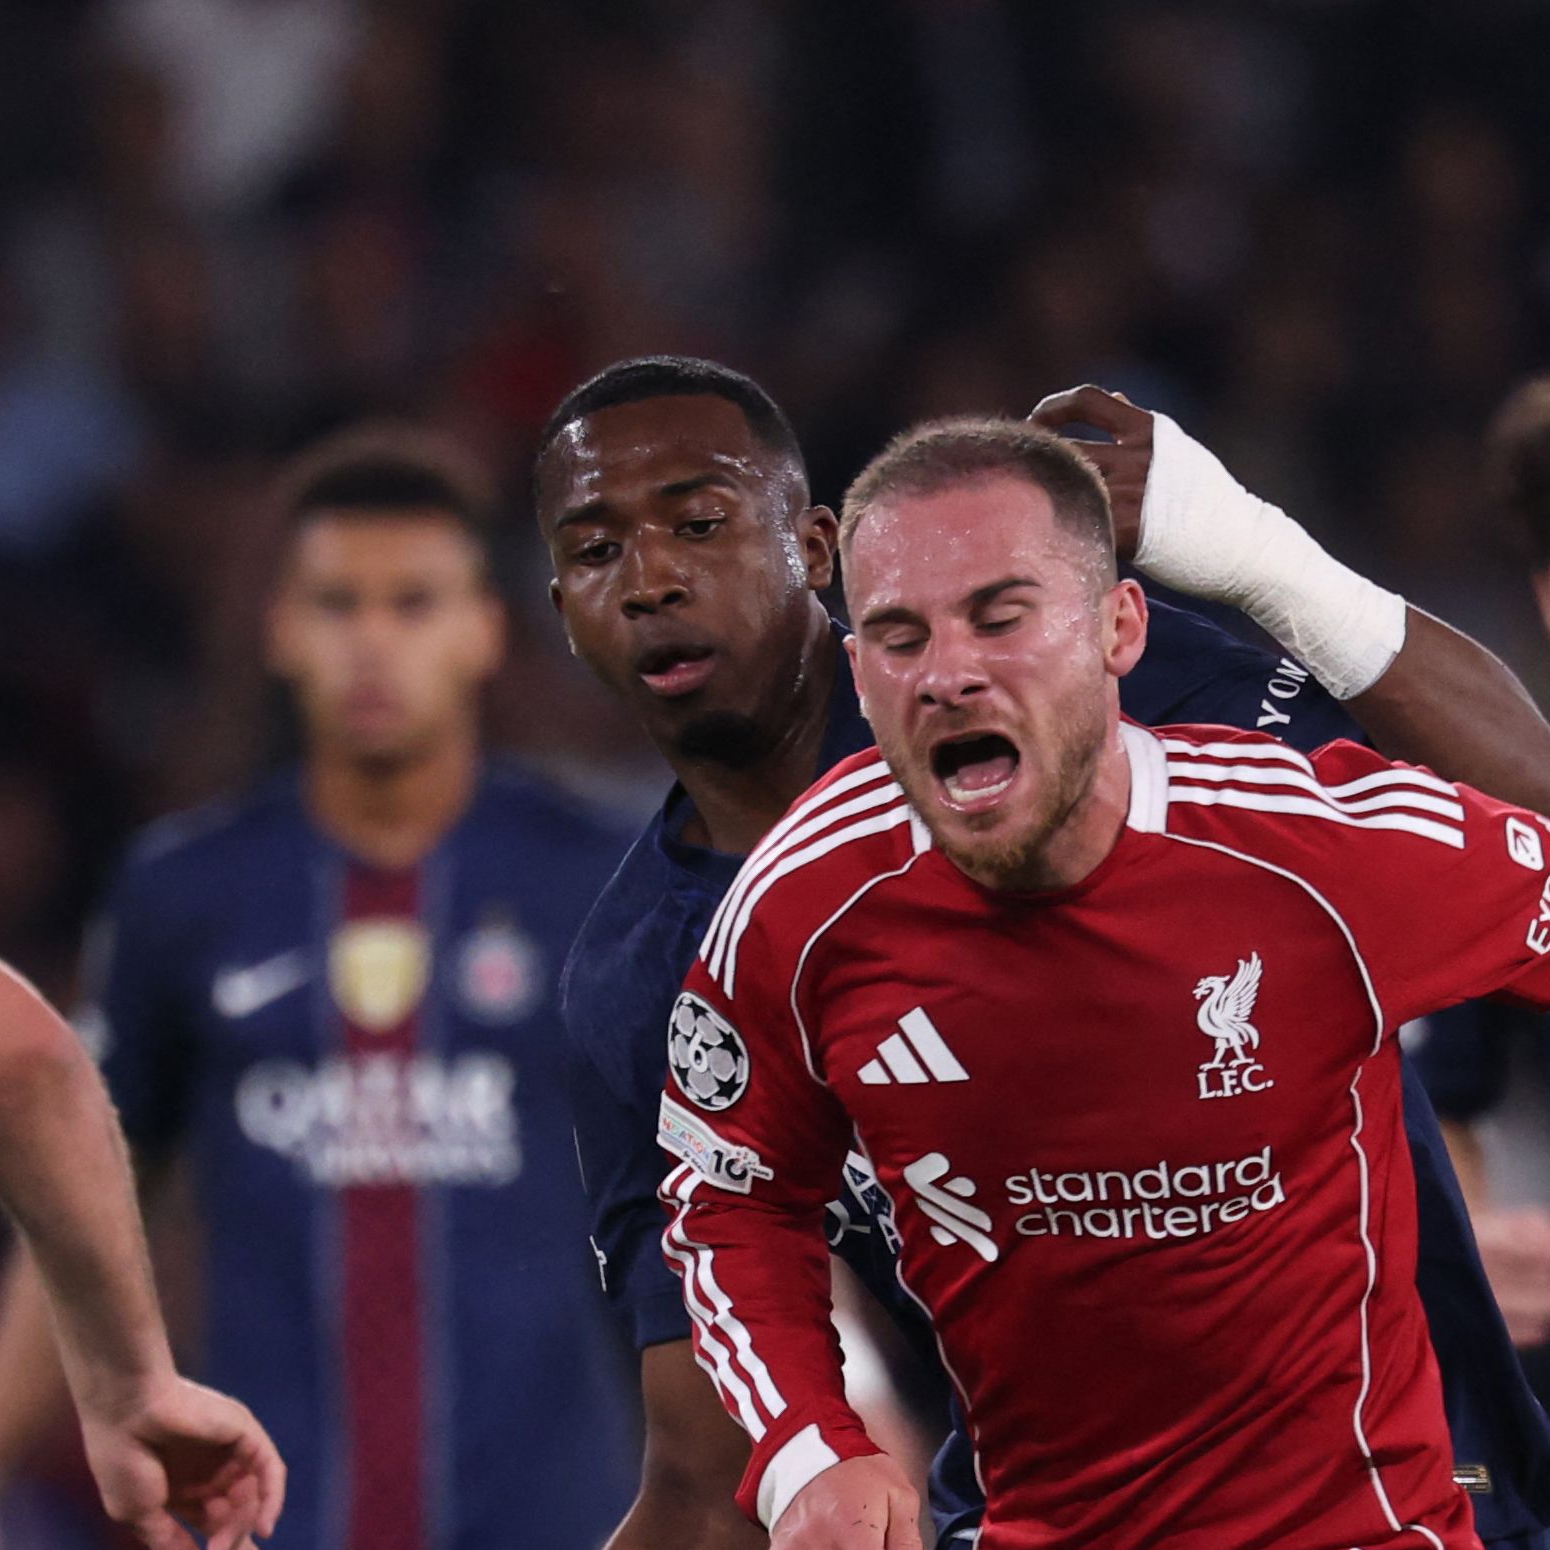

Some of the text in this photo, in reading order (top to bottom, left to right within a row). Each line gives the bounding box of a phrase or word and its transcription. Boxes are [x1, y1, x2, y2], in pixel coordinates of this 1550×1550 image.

[688, 1031, 709, 1074] 6
[1005, 1145, 1272, 1205] standard
[1015, 1171, 1287, 1240] chartered
